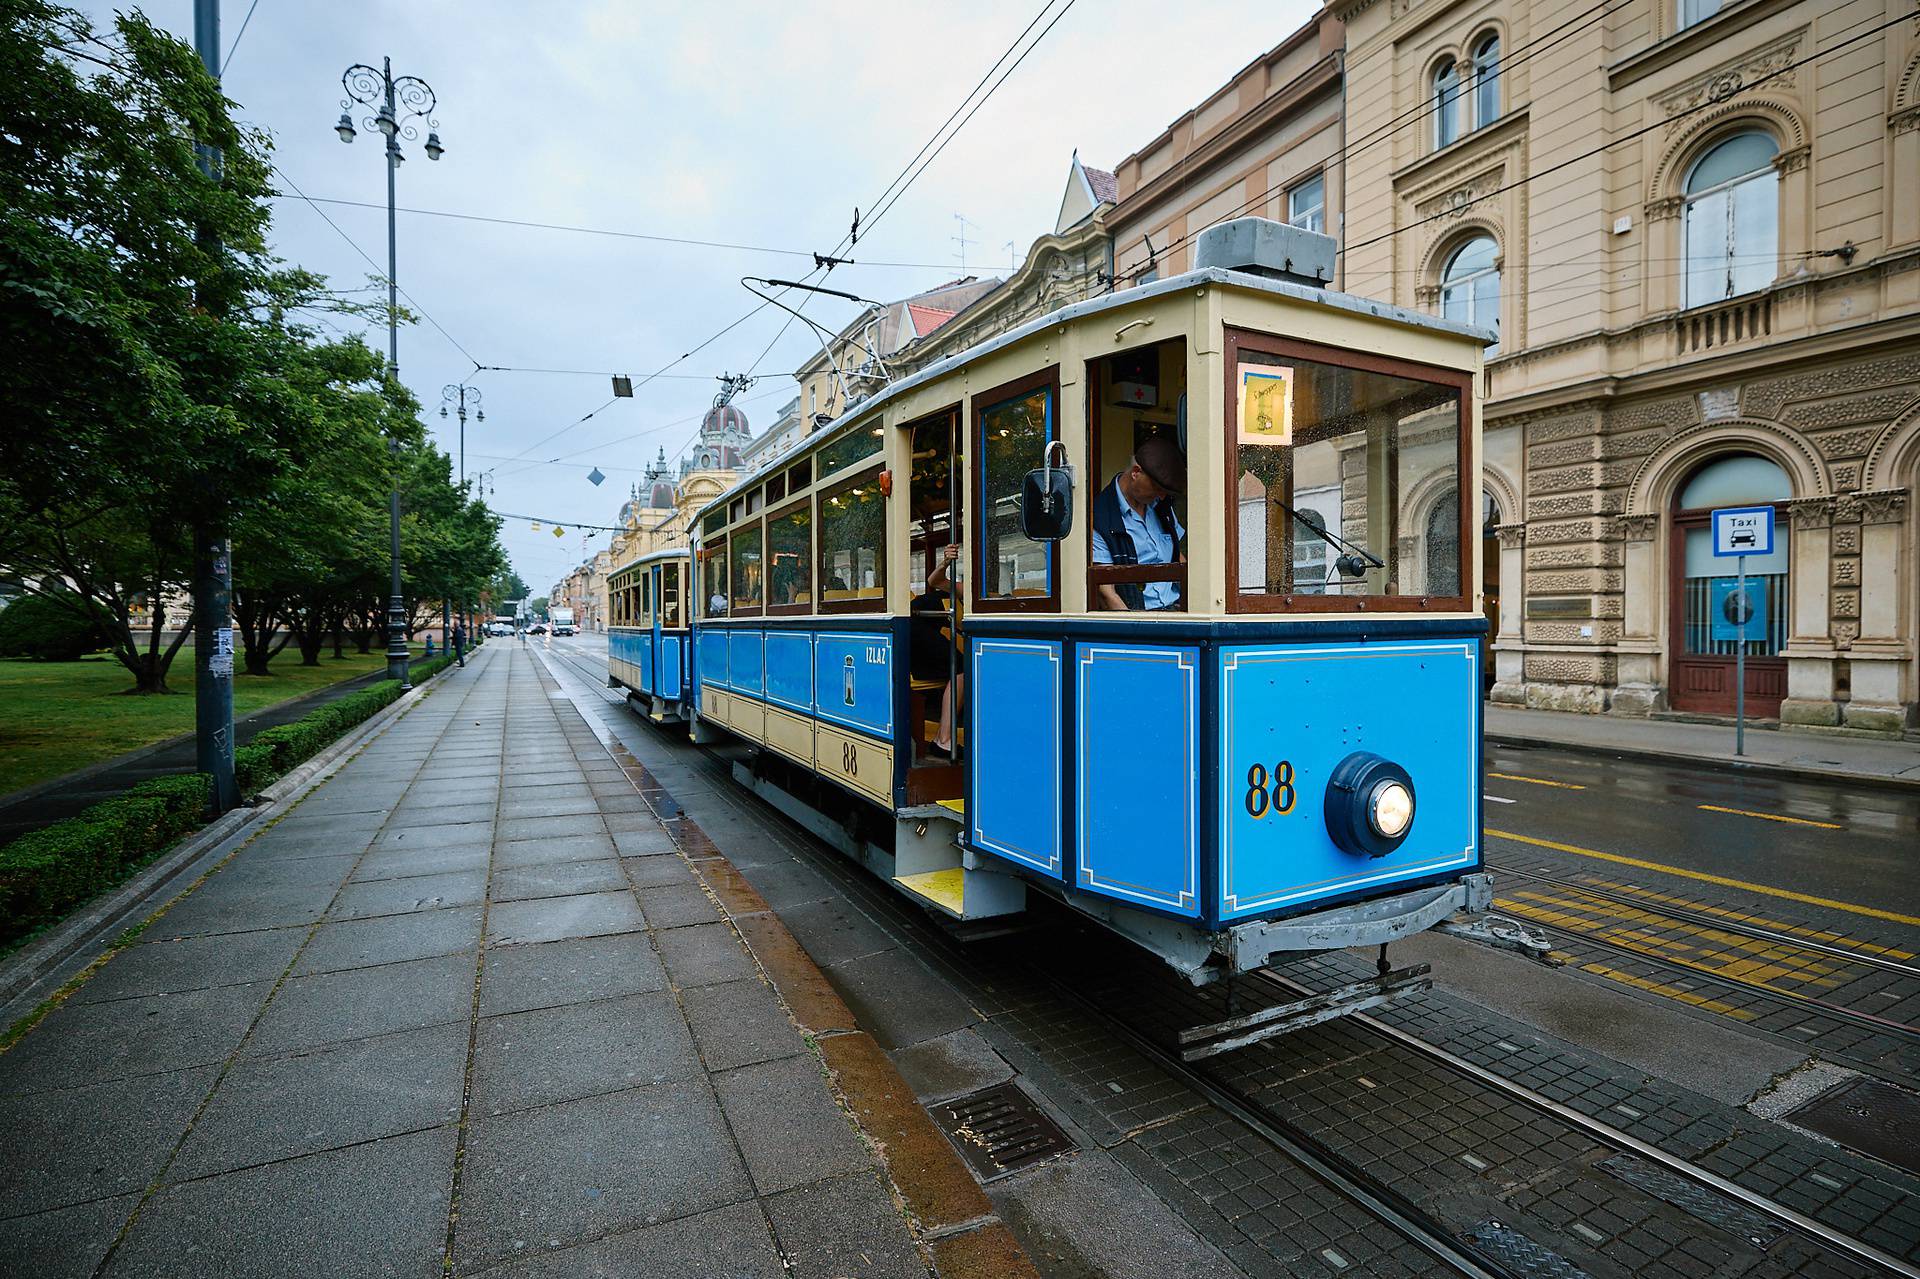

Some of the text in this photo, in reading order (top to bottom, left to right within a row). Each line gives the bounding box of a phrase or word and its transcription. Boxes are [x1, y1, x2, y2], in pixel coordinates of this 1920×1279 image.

[1730, 517, 1757, 527] Taxi
[866, 646, 886, 665] IZLAZ
[842, 741, 857, 776] 88
[1245, 760, 1296, 819] 88
